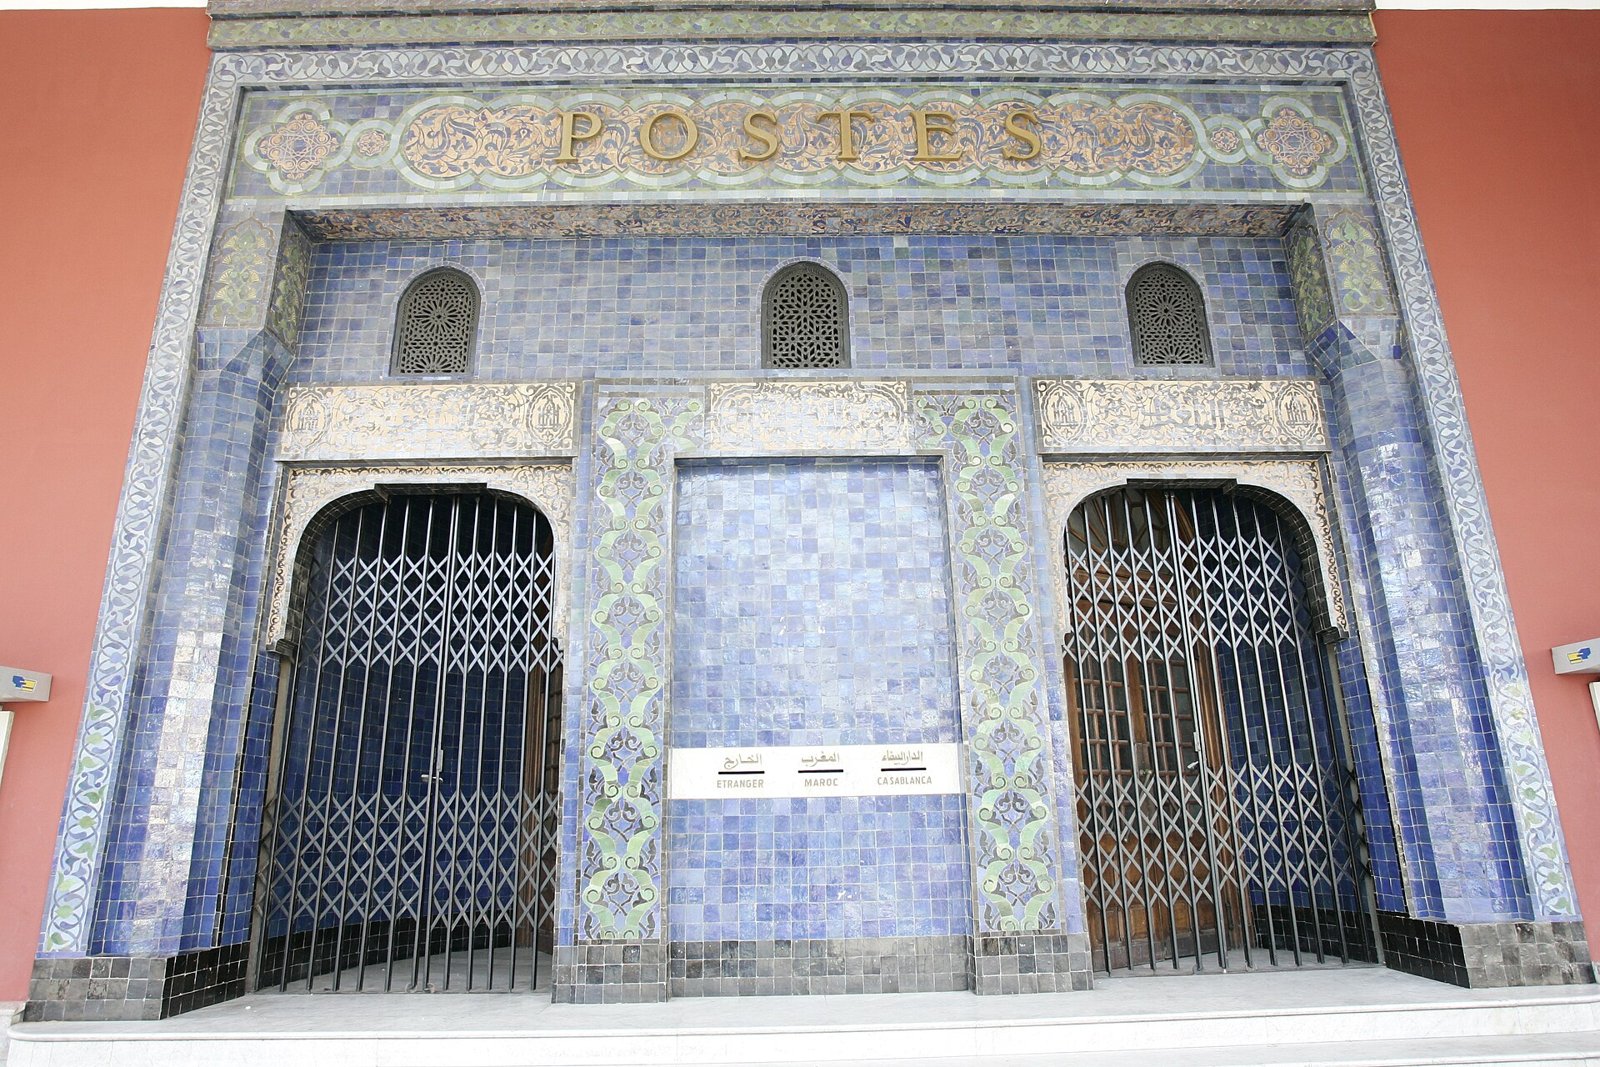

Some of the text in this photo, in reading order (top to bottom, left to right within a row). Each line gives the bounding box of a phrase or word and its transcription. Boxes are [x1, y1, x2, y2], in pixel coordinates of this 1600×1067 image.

[553, 109, 1042, 163] POSTES
[723, 752, 763, 770] الخارج
[801, 750, 840, 768] المغرب
[716, 779, 765, 789] ETRANGER
[804, 777, 839, 788] MAROC
[877, 775, 933, 786] CASABLANCA
